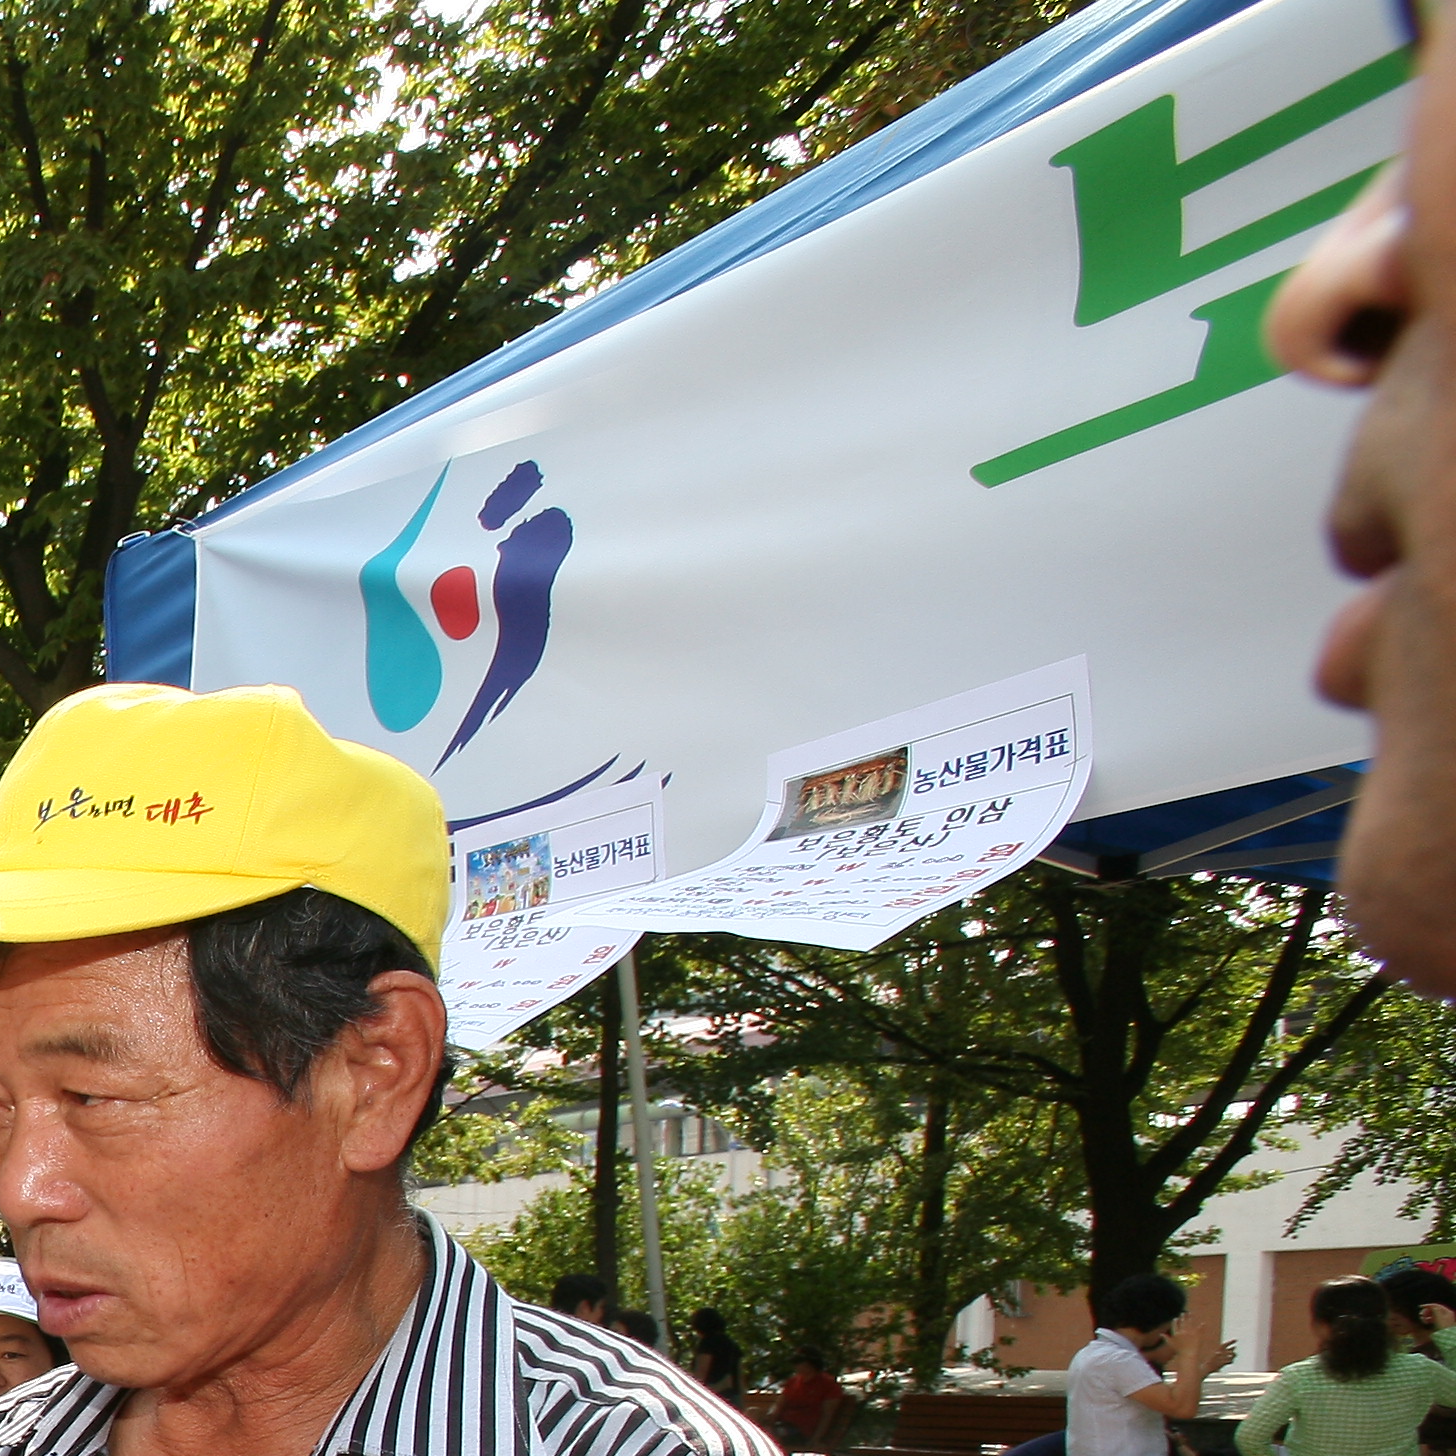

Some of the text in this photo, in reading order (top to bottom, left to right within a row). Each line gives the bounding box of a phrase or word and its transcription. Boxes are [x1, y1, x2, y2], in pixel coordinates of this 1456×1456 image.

[913, 728, 1071, 794] 농산물가격표
[146, 791, 214, 826] 대추
[789, 797, 1014, 854] 보은황토 인삼
[553, 834, 651, 878] 농산물가격표
[815, 831, 951, 861] (보은산)
[976, 841, 1025, 864] 원
[484, 927, 572, 951] (보은산)
